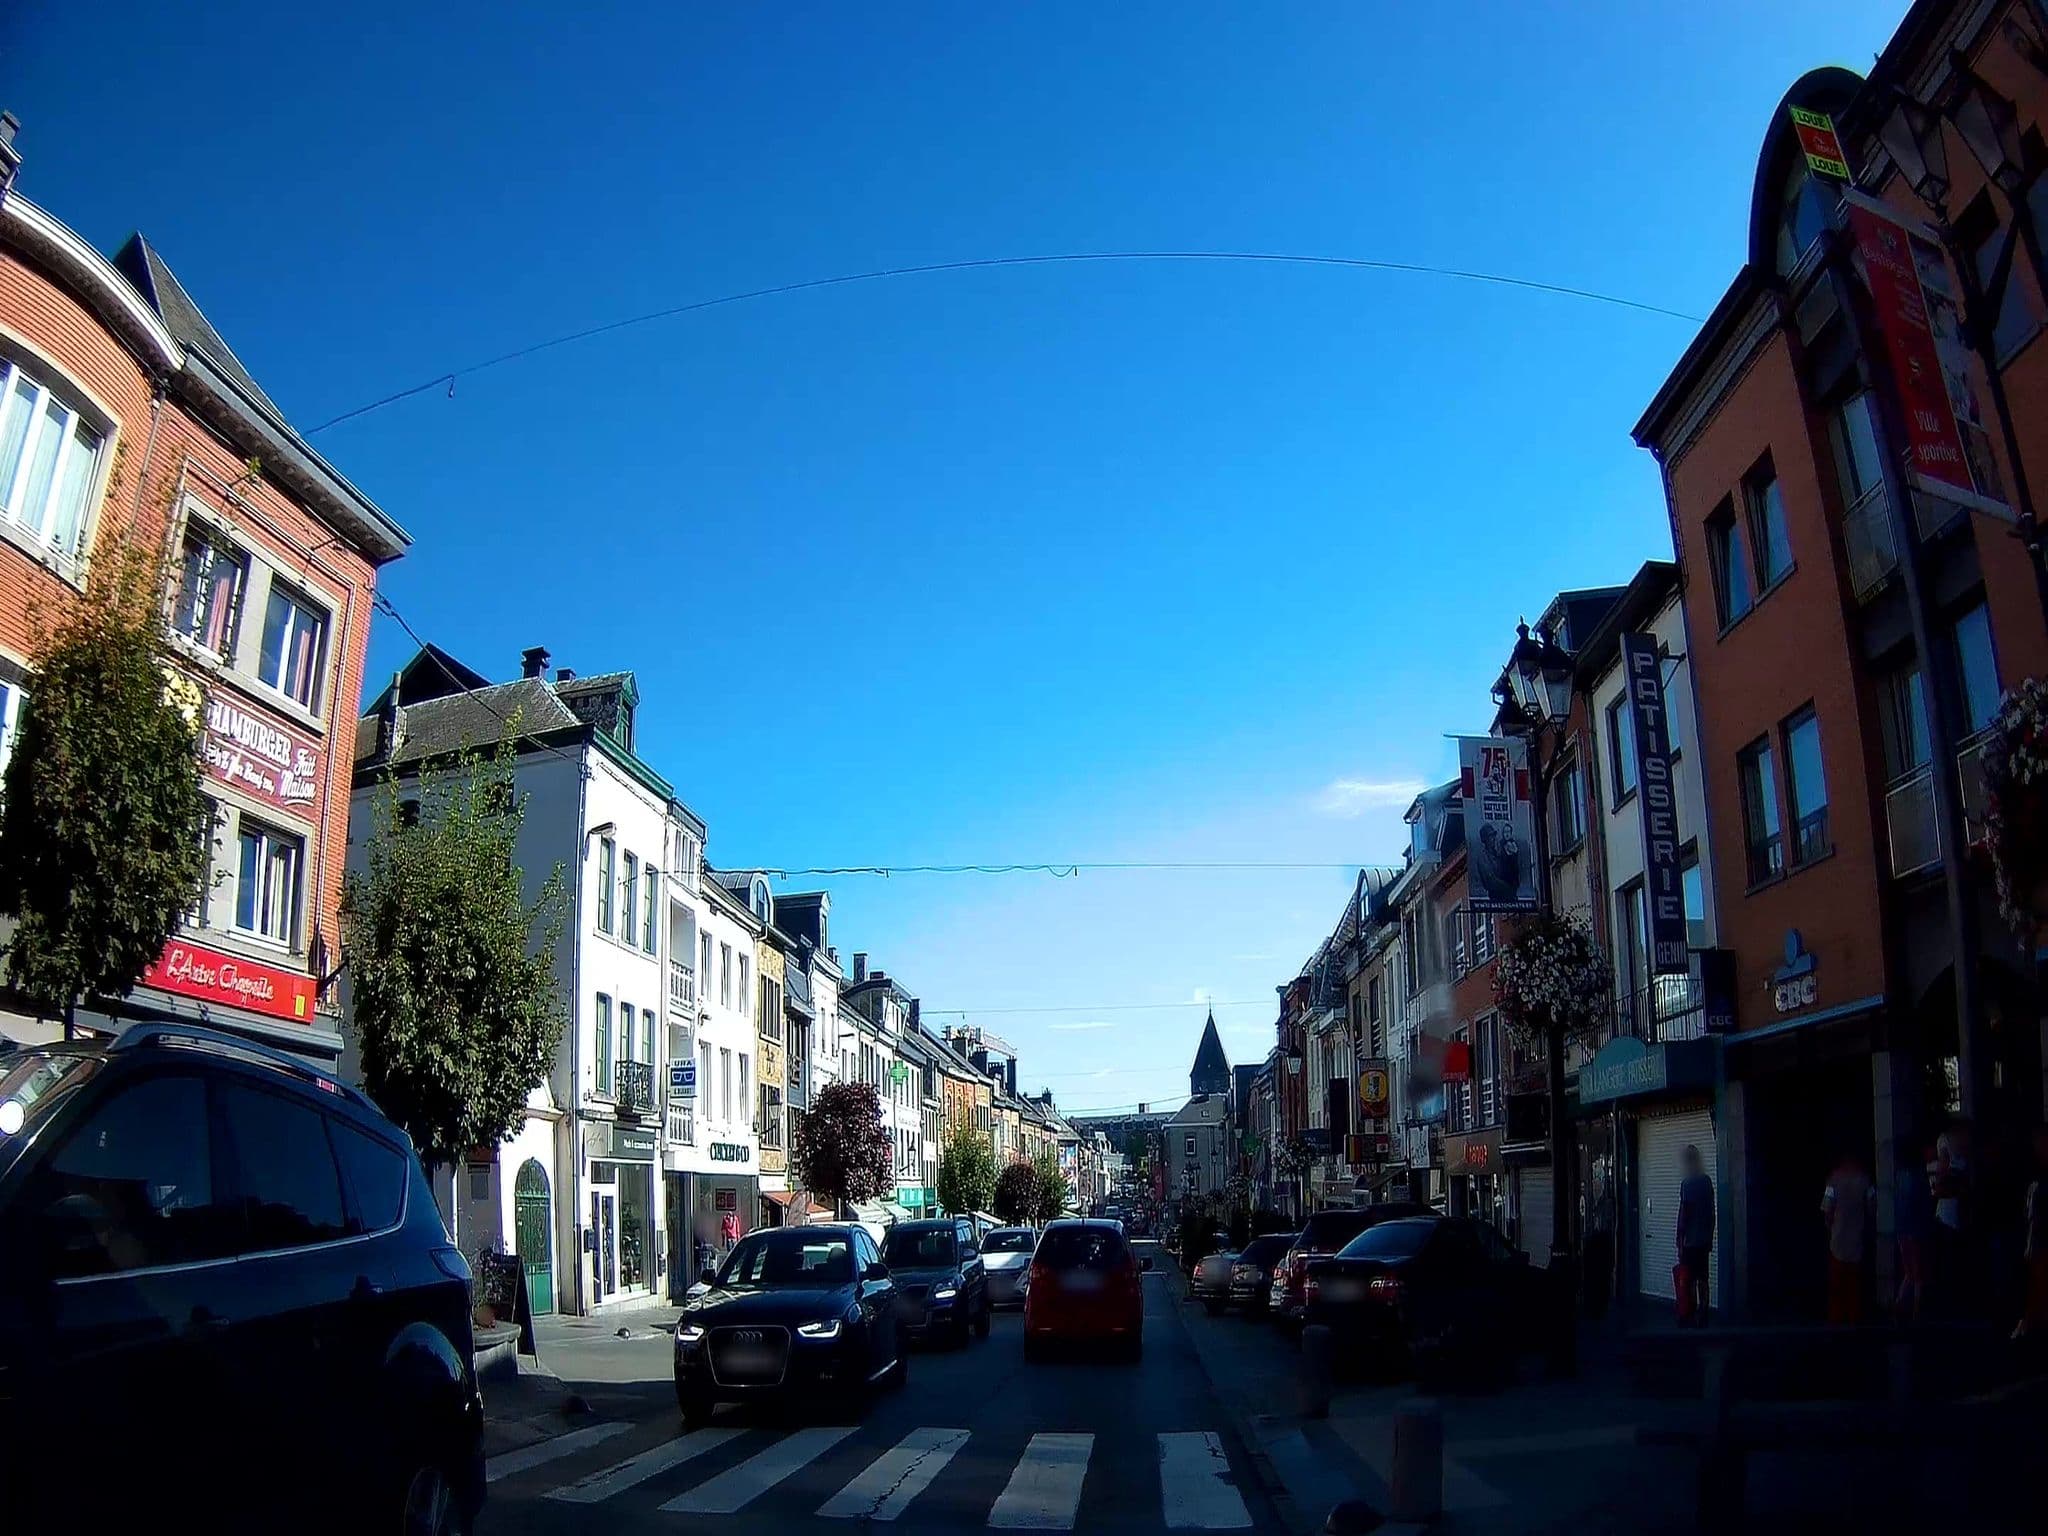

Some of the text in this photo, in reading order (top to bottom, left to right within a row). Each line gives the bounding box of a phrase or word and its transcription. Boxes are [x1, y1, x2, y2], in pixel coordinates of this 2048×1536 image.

[1796, 111, 1825, 127] LOUE
[1812, 157, 1842, 174] LOUE
[1913, 408, 1941, 433] Ville
[1918, 440, 1960, 464] sportive
[208, 700, 292, 767] HAMBURGER
[281, 769, 317, 800] Maison
[1633, 652, 1680, 921] PATISSERIE
[1708, 1015, 1733, 1026] CBC
